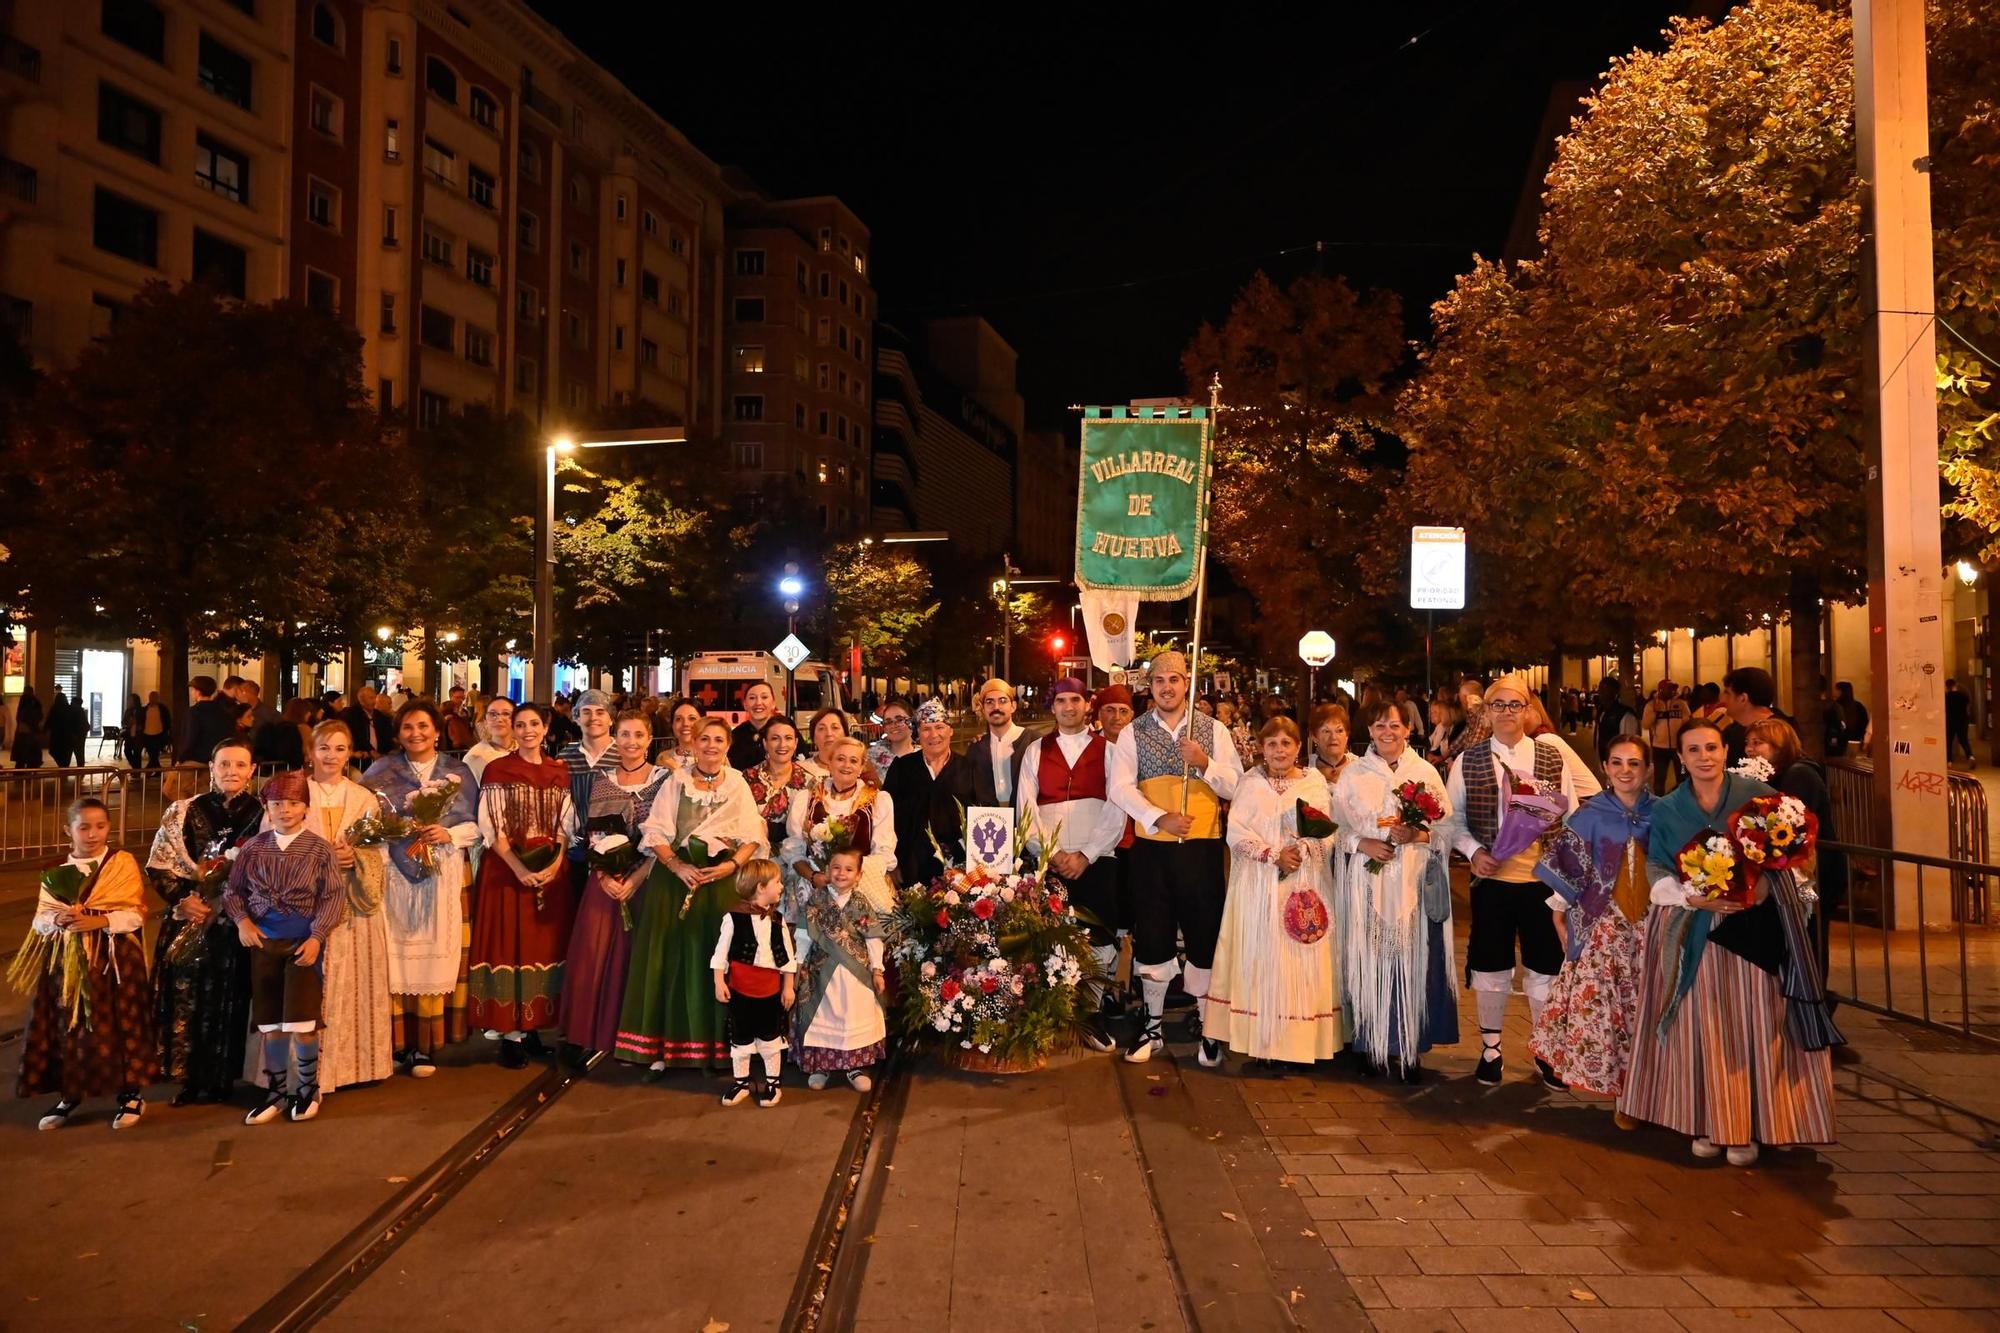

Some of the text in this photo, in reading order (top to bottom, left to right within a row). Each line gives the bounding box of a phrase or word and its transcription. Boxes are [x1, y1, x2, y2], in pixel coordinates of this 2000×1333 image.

[1090, 450, 1196, 484] VILLARREAL
[1127, 494, 1153, 516] DE
[1091, 531, 1182, 559] HUERVA
[784, 645, 800, 659] 30
[698, 665, 757, 674] AMBULANCIA
[1893, 741, 1910, 755] AWA
